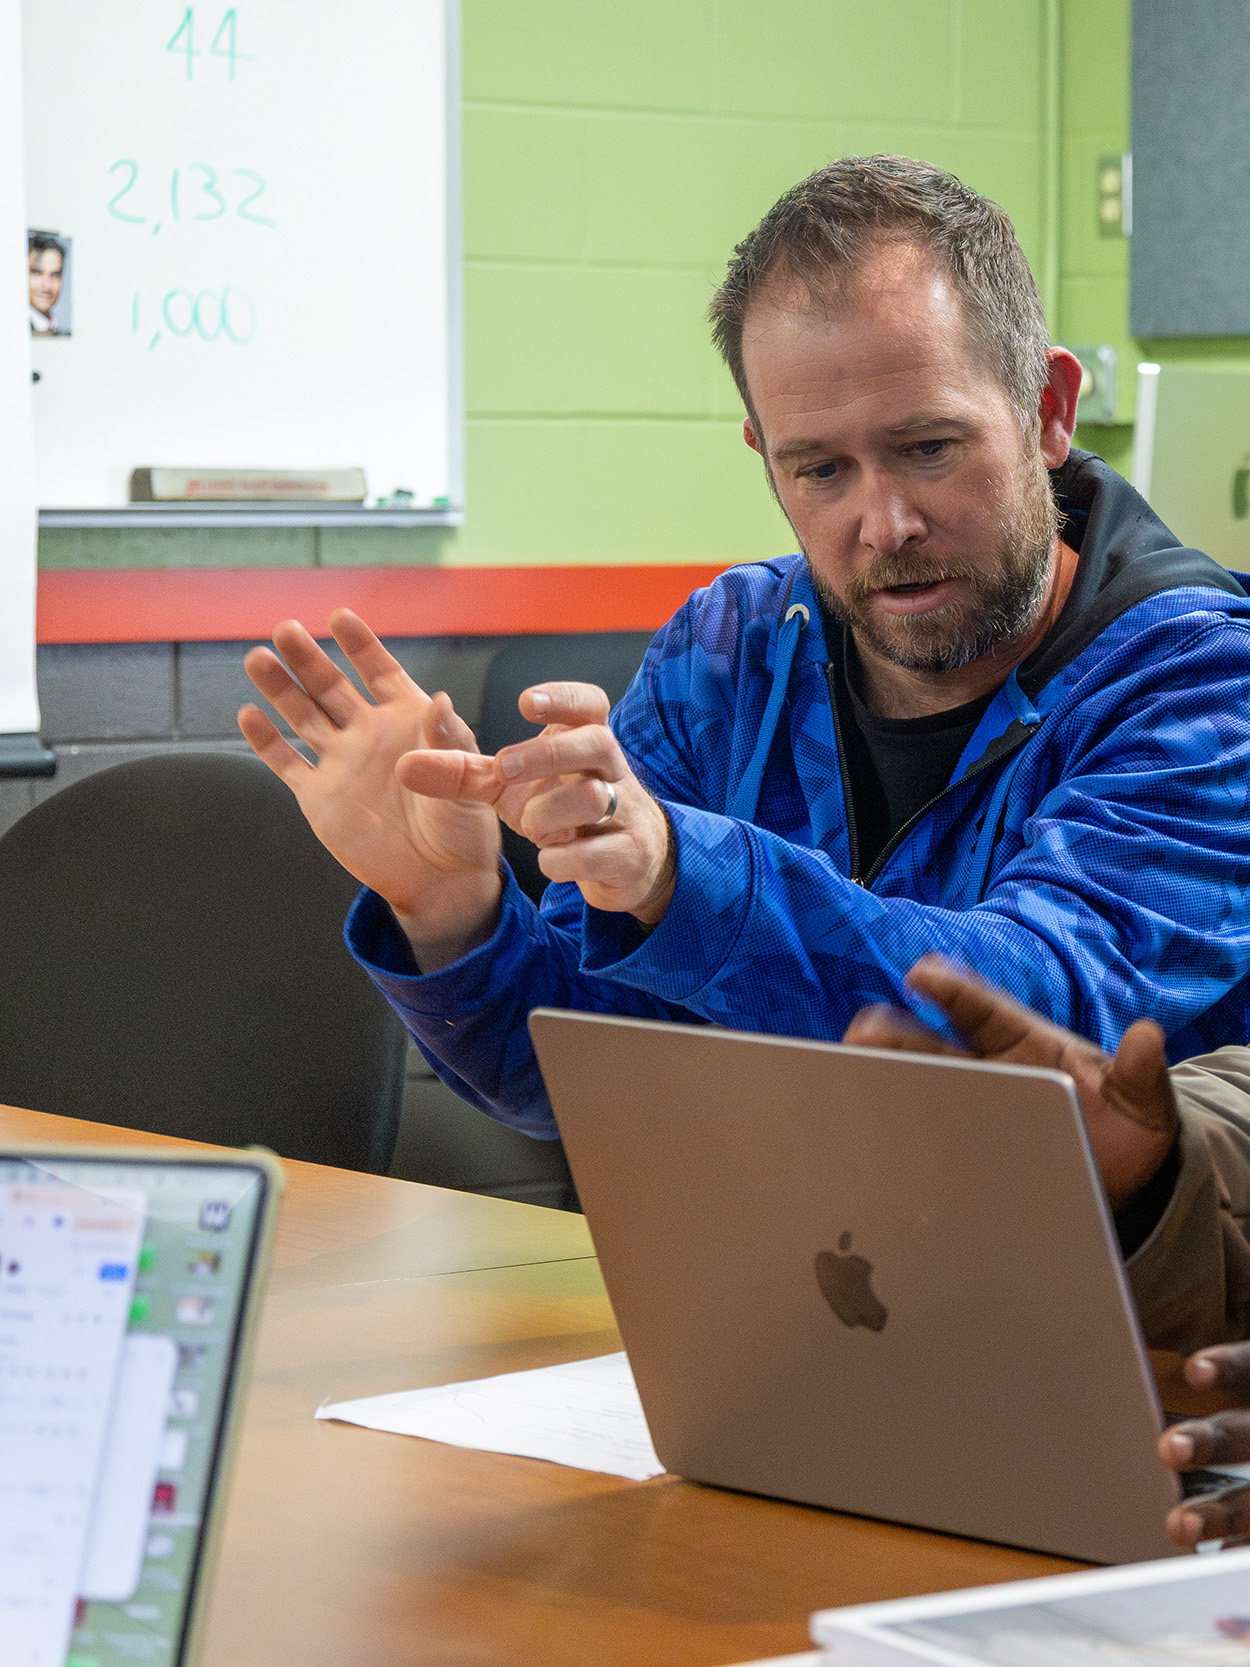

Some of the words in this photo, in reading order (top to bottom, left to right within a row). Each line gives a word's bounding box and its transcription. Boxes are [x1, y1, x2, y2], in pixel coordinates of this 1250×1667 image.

[164, 5, 254, 82] 44
[106, 157, 278, 237] 2,132
[131, 284, 257, 352] 1,000
